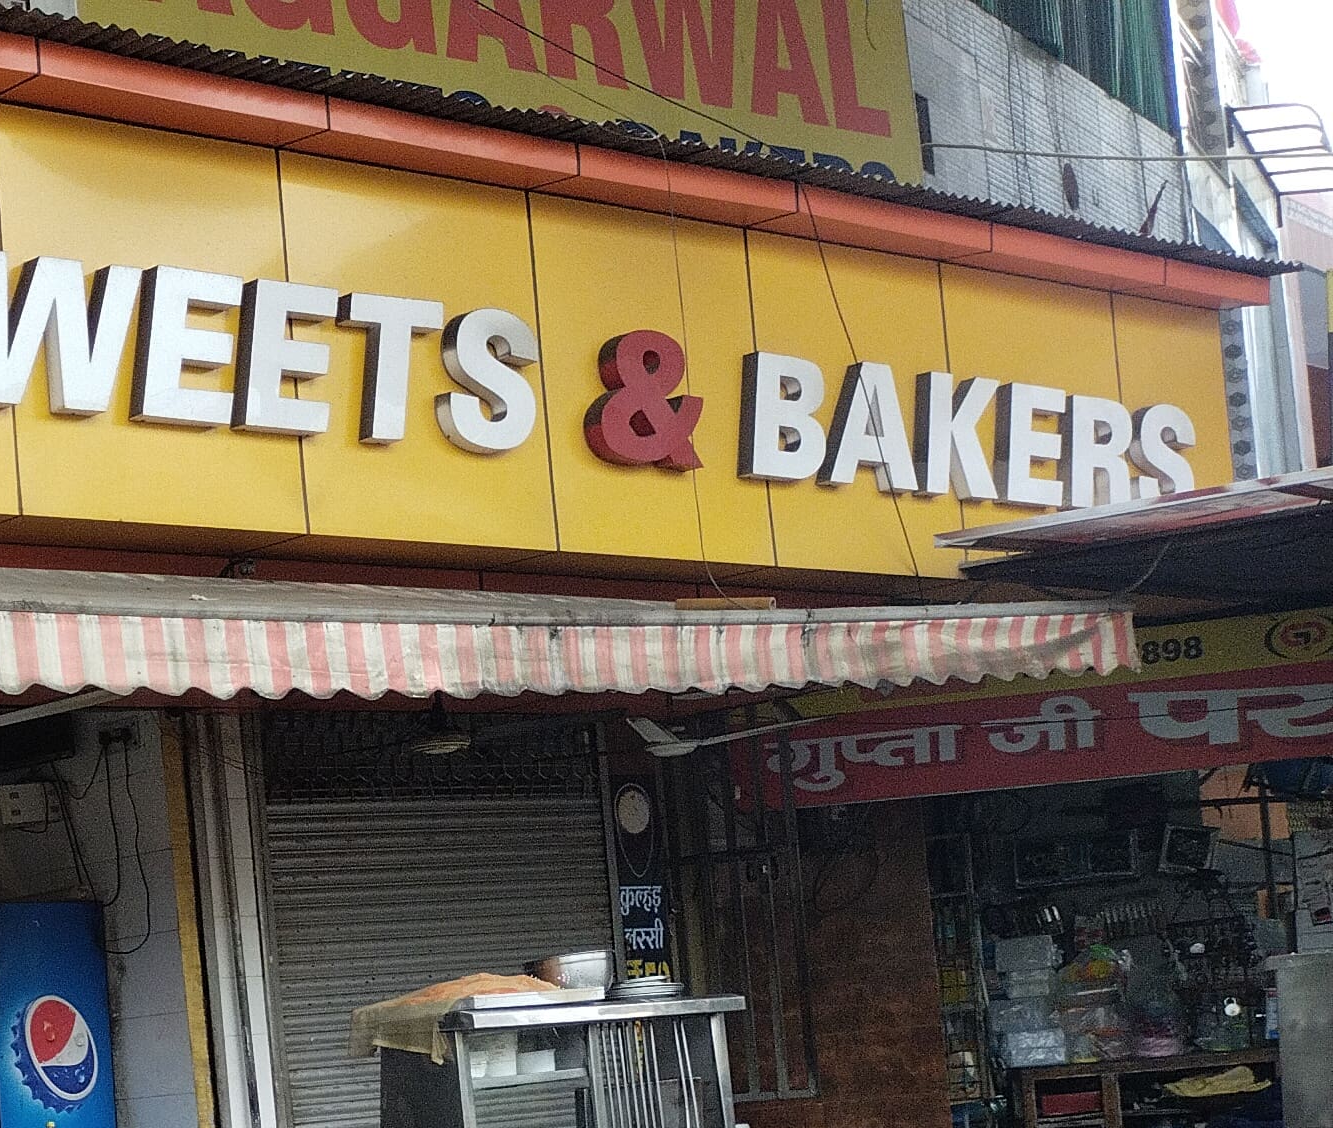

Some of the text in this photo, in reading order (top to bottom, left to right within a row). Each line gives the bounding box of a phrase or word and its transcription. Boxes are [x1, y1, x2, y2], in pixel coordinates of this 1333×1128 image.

[584, 329, 703, 472] &
[739, 350, 1196, 510] BAKERS
[765, 724, 964, 792] गुप्ता
[979, 696, 1101, 754] जी
[619, 885, 663, 916] कुल्हड़
